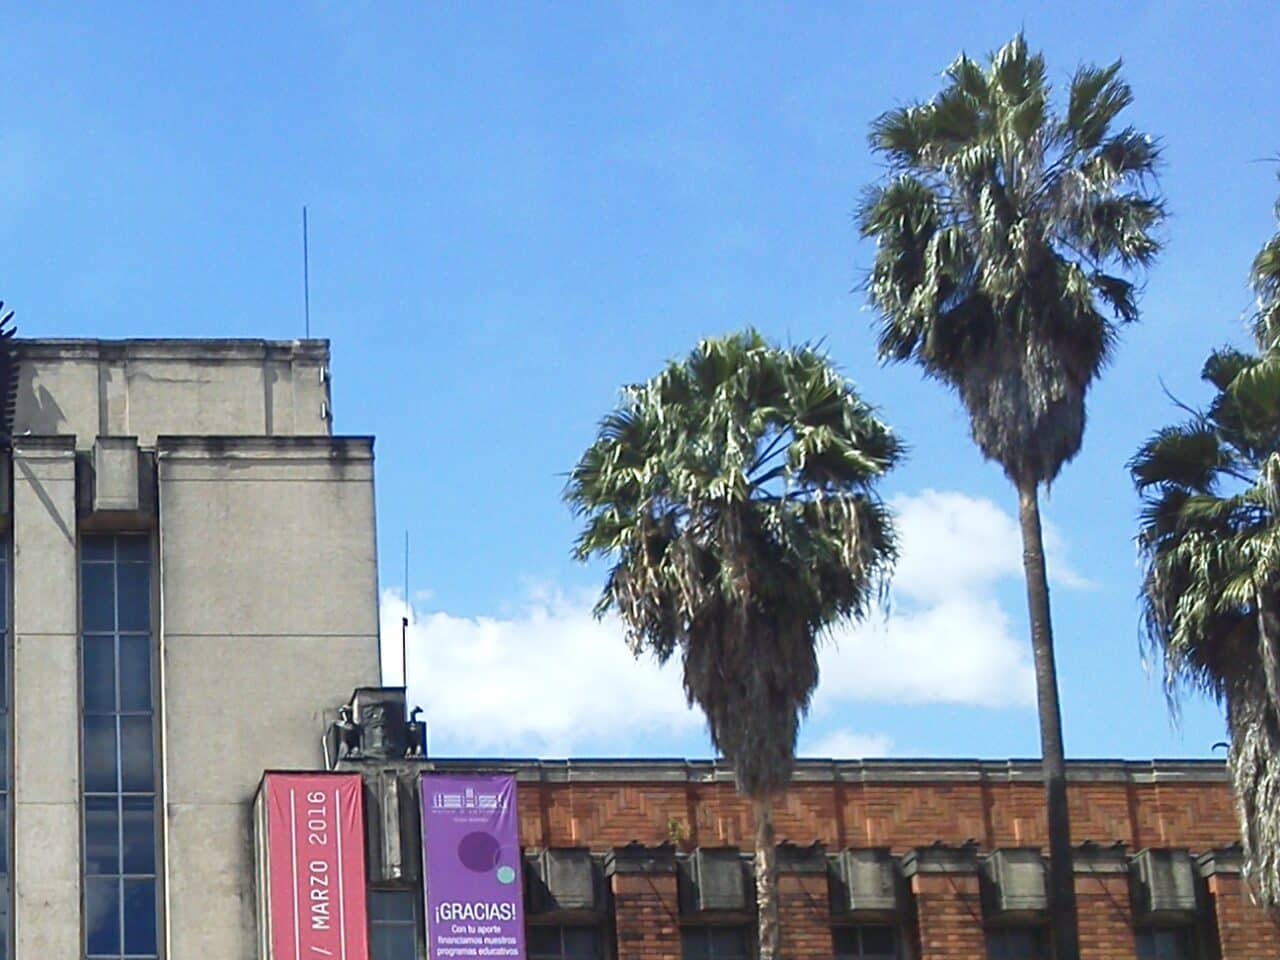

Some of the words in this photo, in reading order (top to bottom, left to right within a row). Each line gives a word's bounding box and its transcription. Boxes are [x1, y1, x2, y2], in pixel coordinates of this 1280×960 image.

[307, 791, 328, 845] 2016
[310, 860, 331, 930] MARZO
[435, 902, 516, 924] ¡GRACIAS!
[451, 924, 467, 933] Con
